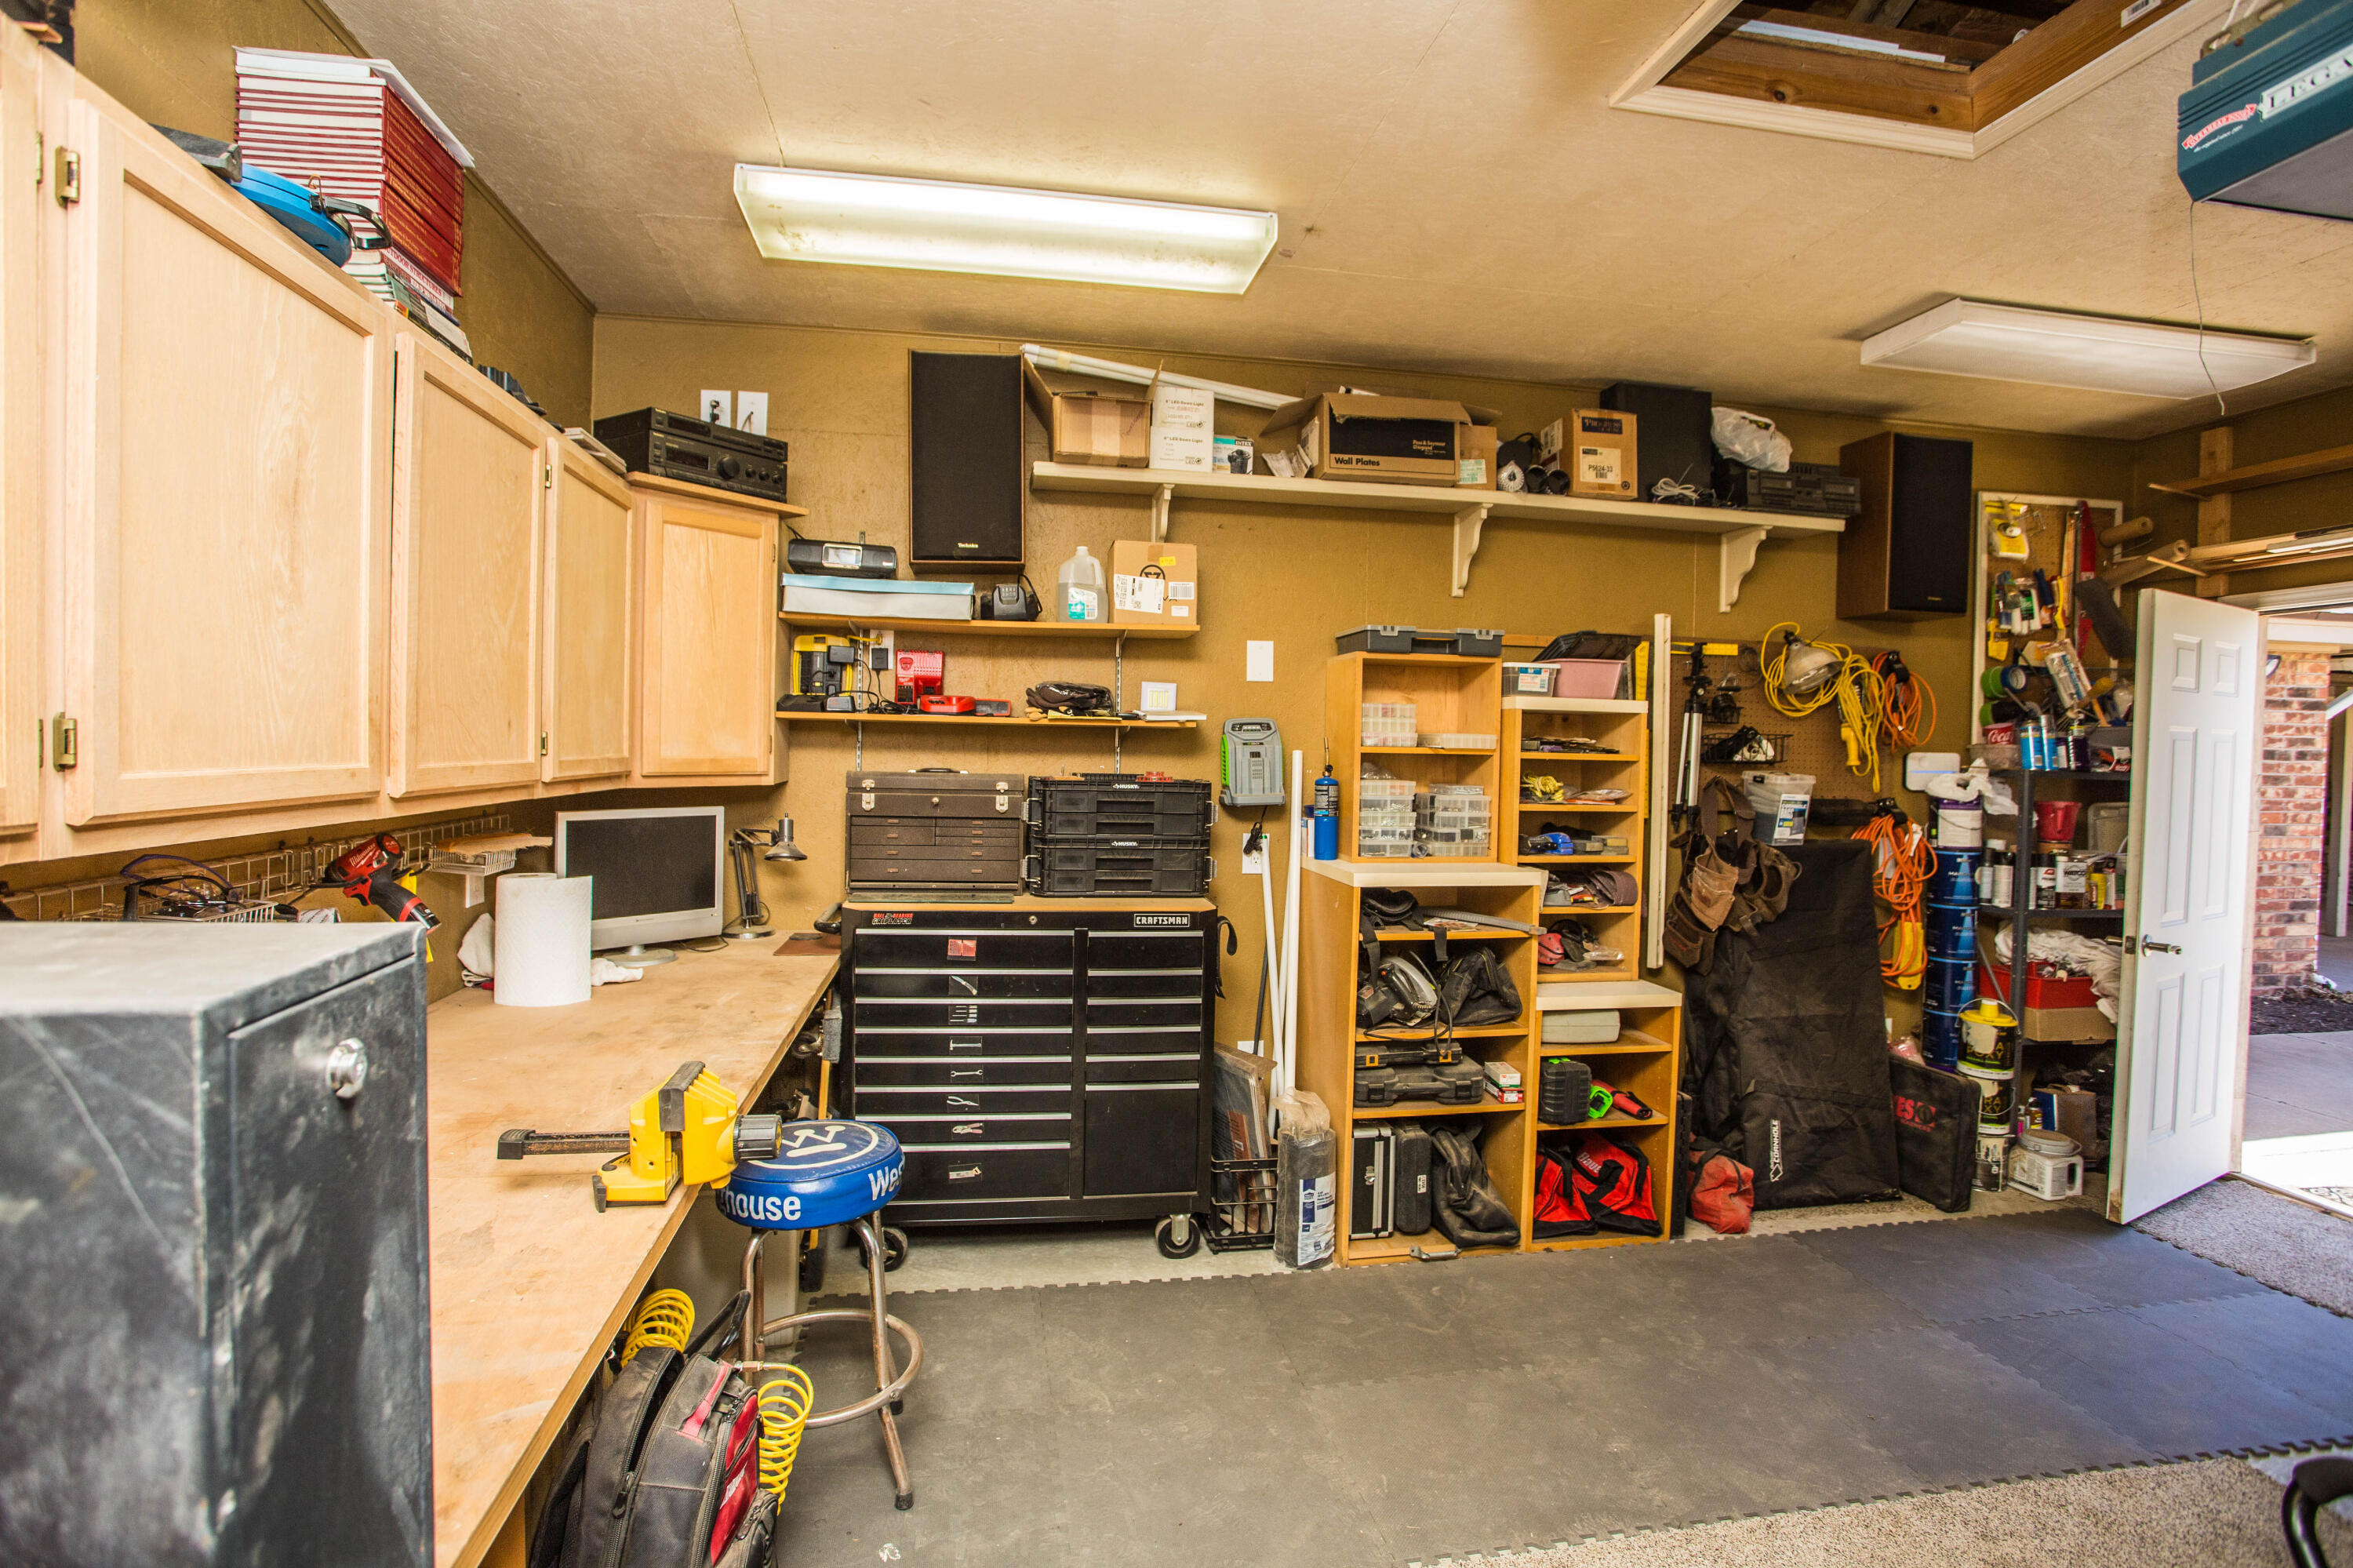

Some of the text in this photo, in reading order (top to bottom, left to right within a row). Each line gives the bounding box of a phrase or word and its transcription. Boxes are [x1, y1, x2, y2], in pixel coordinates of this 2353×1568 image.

[387, 248, 409, 271] UTDOOR
[1334, 457, 1380, 467] Wall Plates
[1988, 729, 2012, 743] Coca
[349, 843, 376, 867] Milwaukee
[1136, 916, 1188, 925] CRAFTSMAN
[1892, 1096, 1915, 1119] ES
[868, 1155, 906, 1201] Wes
